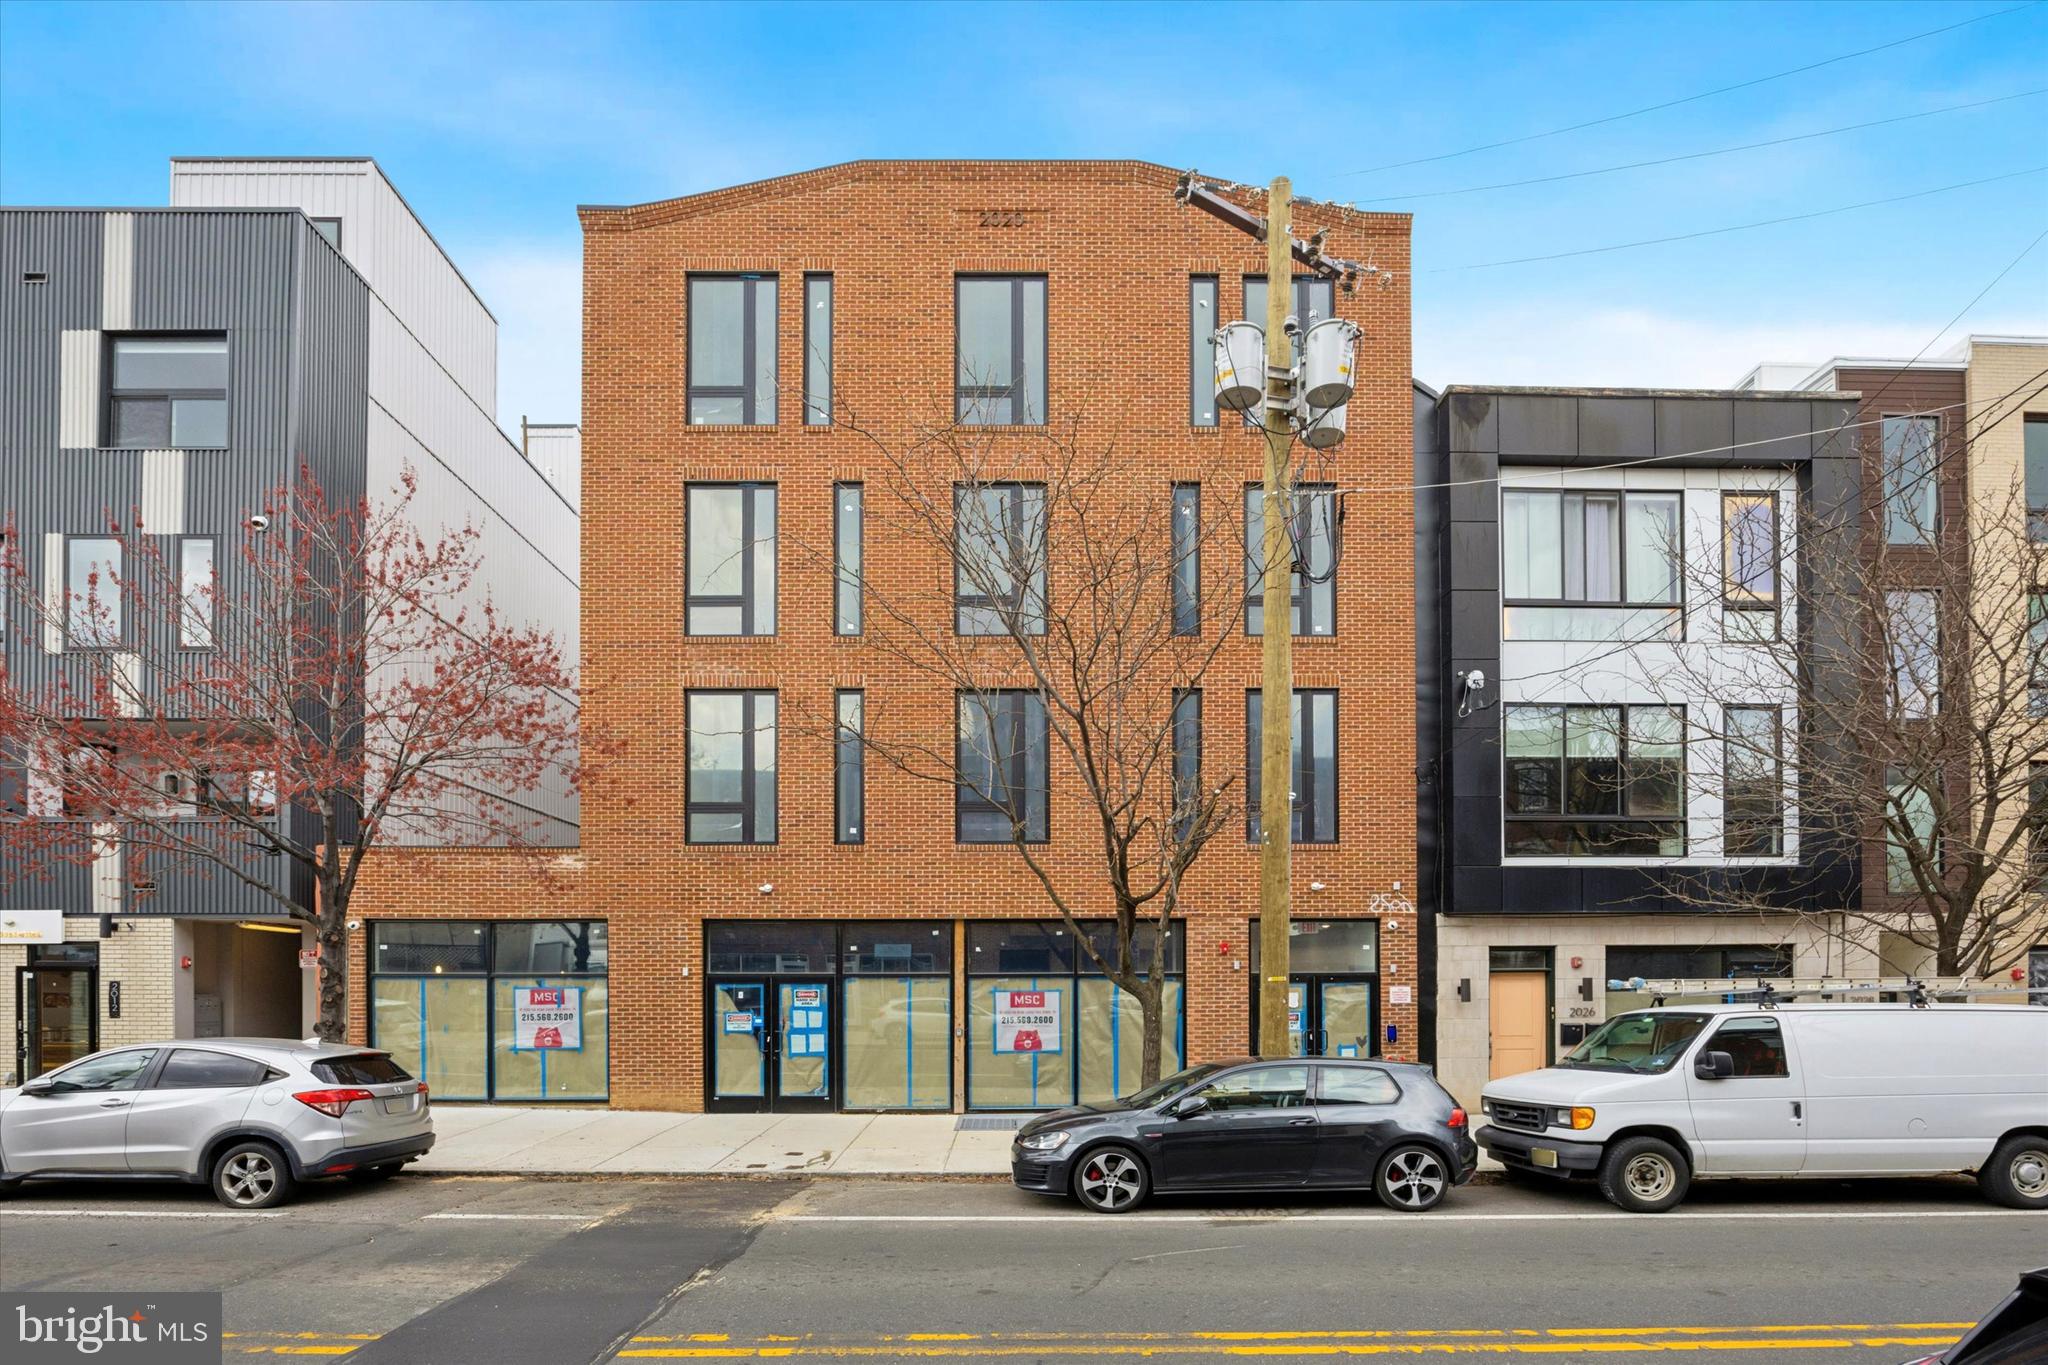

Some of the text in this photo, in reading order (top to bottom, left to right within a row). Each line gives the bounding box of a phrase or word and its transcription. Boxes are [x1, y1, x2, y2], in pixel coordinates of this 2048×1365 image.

[980, 212, 1024, 227] 2020
[110, 982, 118, 1012] 2012
[1014, 995, 1040, 1005] MSC
[1569, 1008, 1596, 1017] 2026
